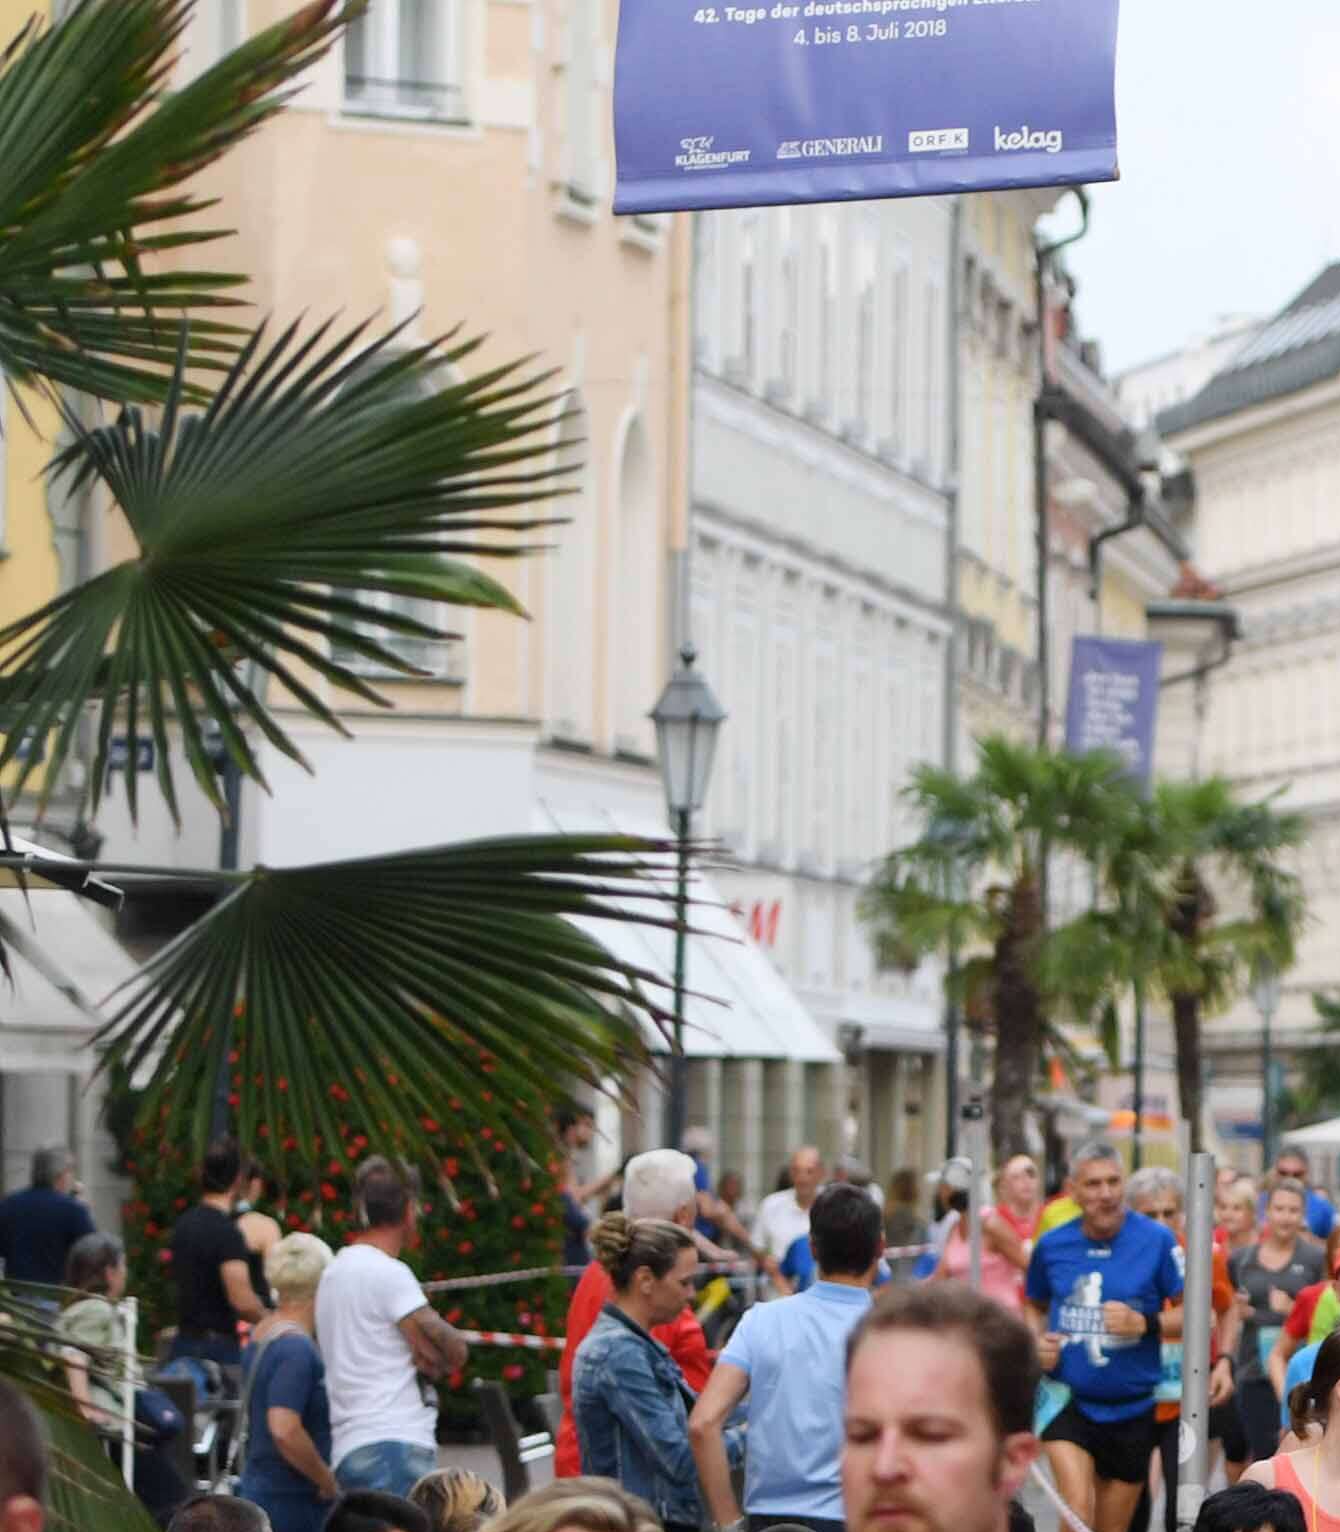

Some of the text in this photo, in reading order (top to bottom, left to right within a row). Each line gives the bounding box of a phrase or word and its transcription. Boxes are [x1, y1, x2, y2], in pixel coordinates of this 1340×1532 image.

[694, 8, 720, 23] 42.
[725, 6, 766, 24] Tage
[771, 4, 799, 19] der
[793, 18, 947, 45] 4. bis 8. Juli 2018
[802, 136, 883, 157] GENERALI
[912, 133, 947, 147] ORF
[993, 126, 1063, 154] kelag
[675, 149, 751, 166] KLAGENFURT
